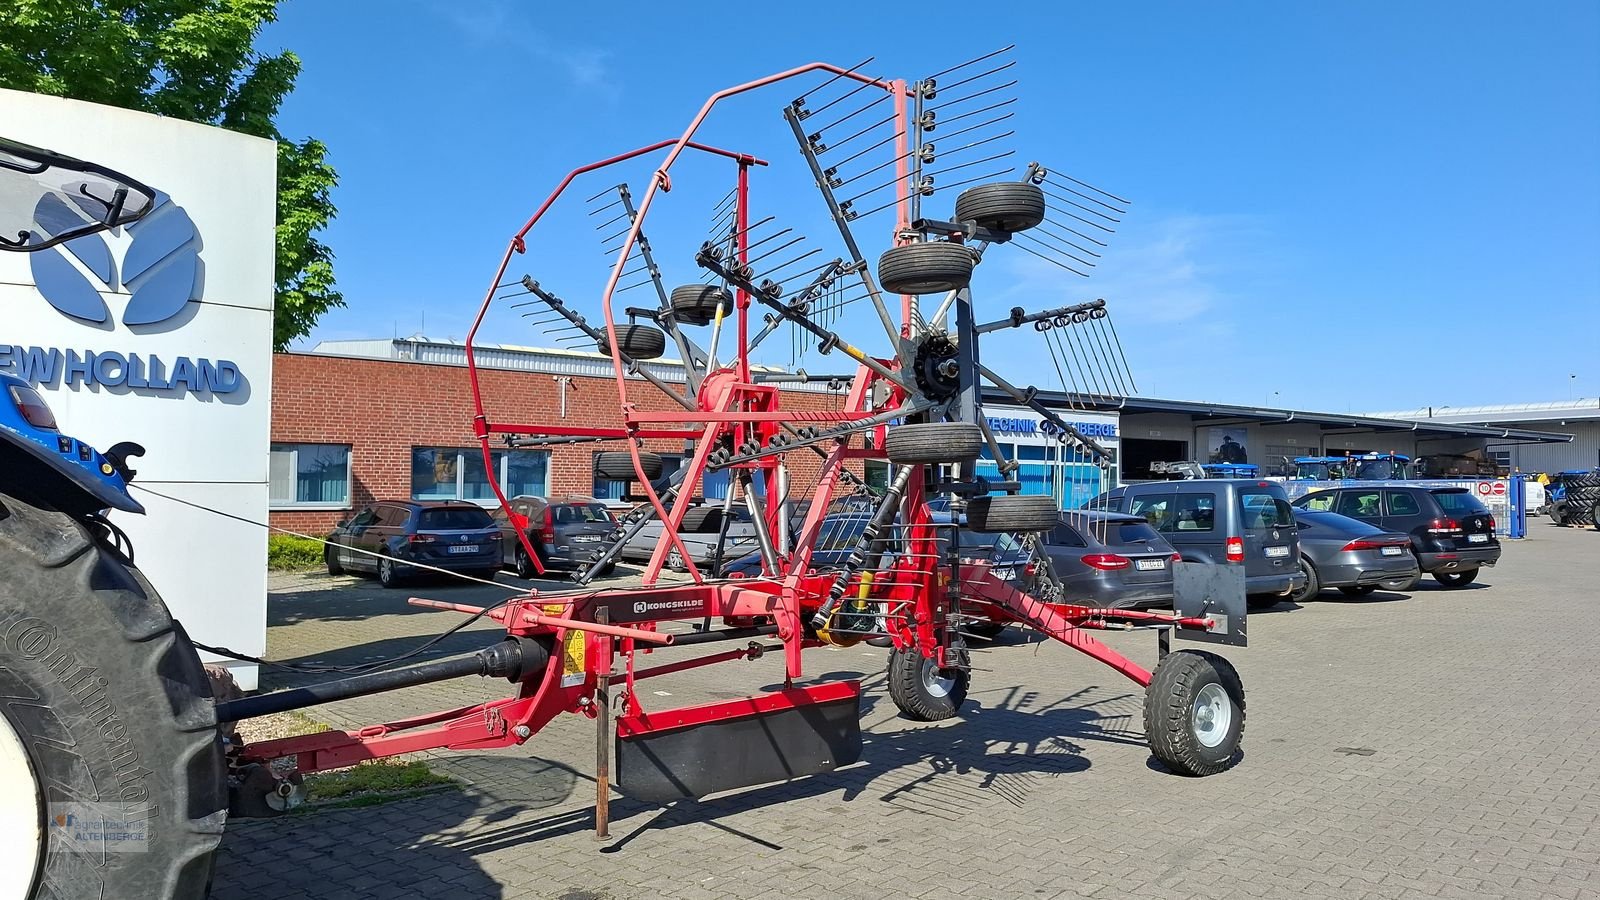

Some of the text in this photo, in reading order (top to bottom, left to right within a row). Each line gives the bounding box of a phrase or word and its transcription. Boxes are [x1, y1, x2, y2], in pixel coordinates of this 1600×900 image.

[65, 348, 239, 393] HOLLAND
[647, 600, 704, 610] KONGSKILDE
[5, 617, 160, 823] Continental
